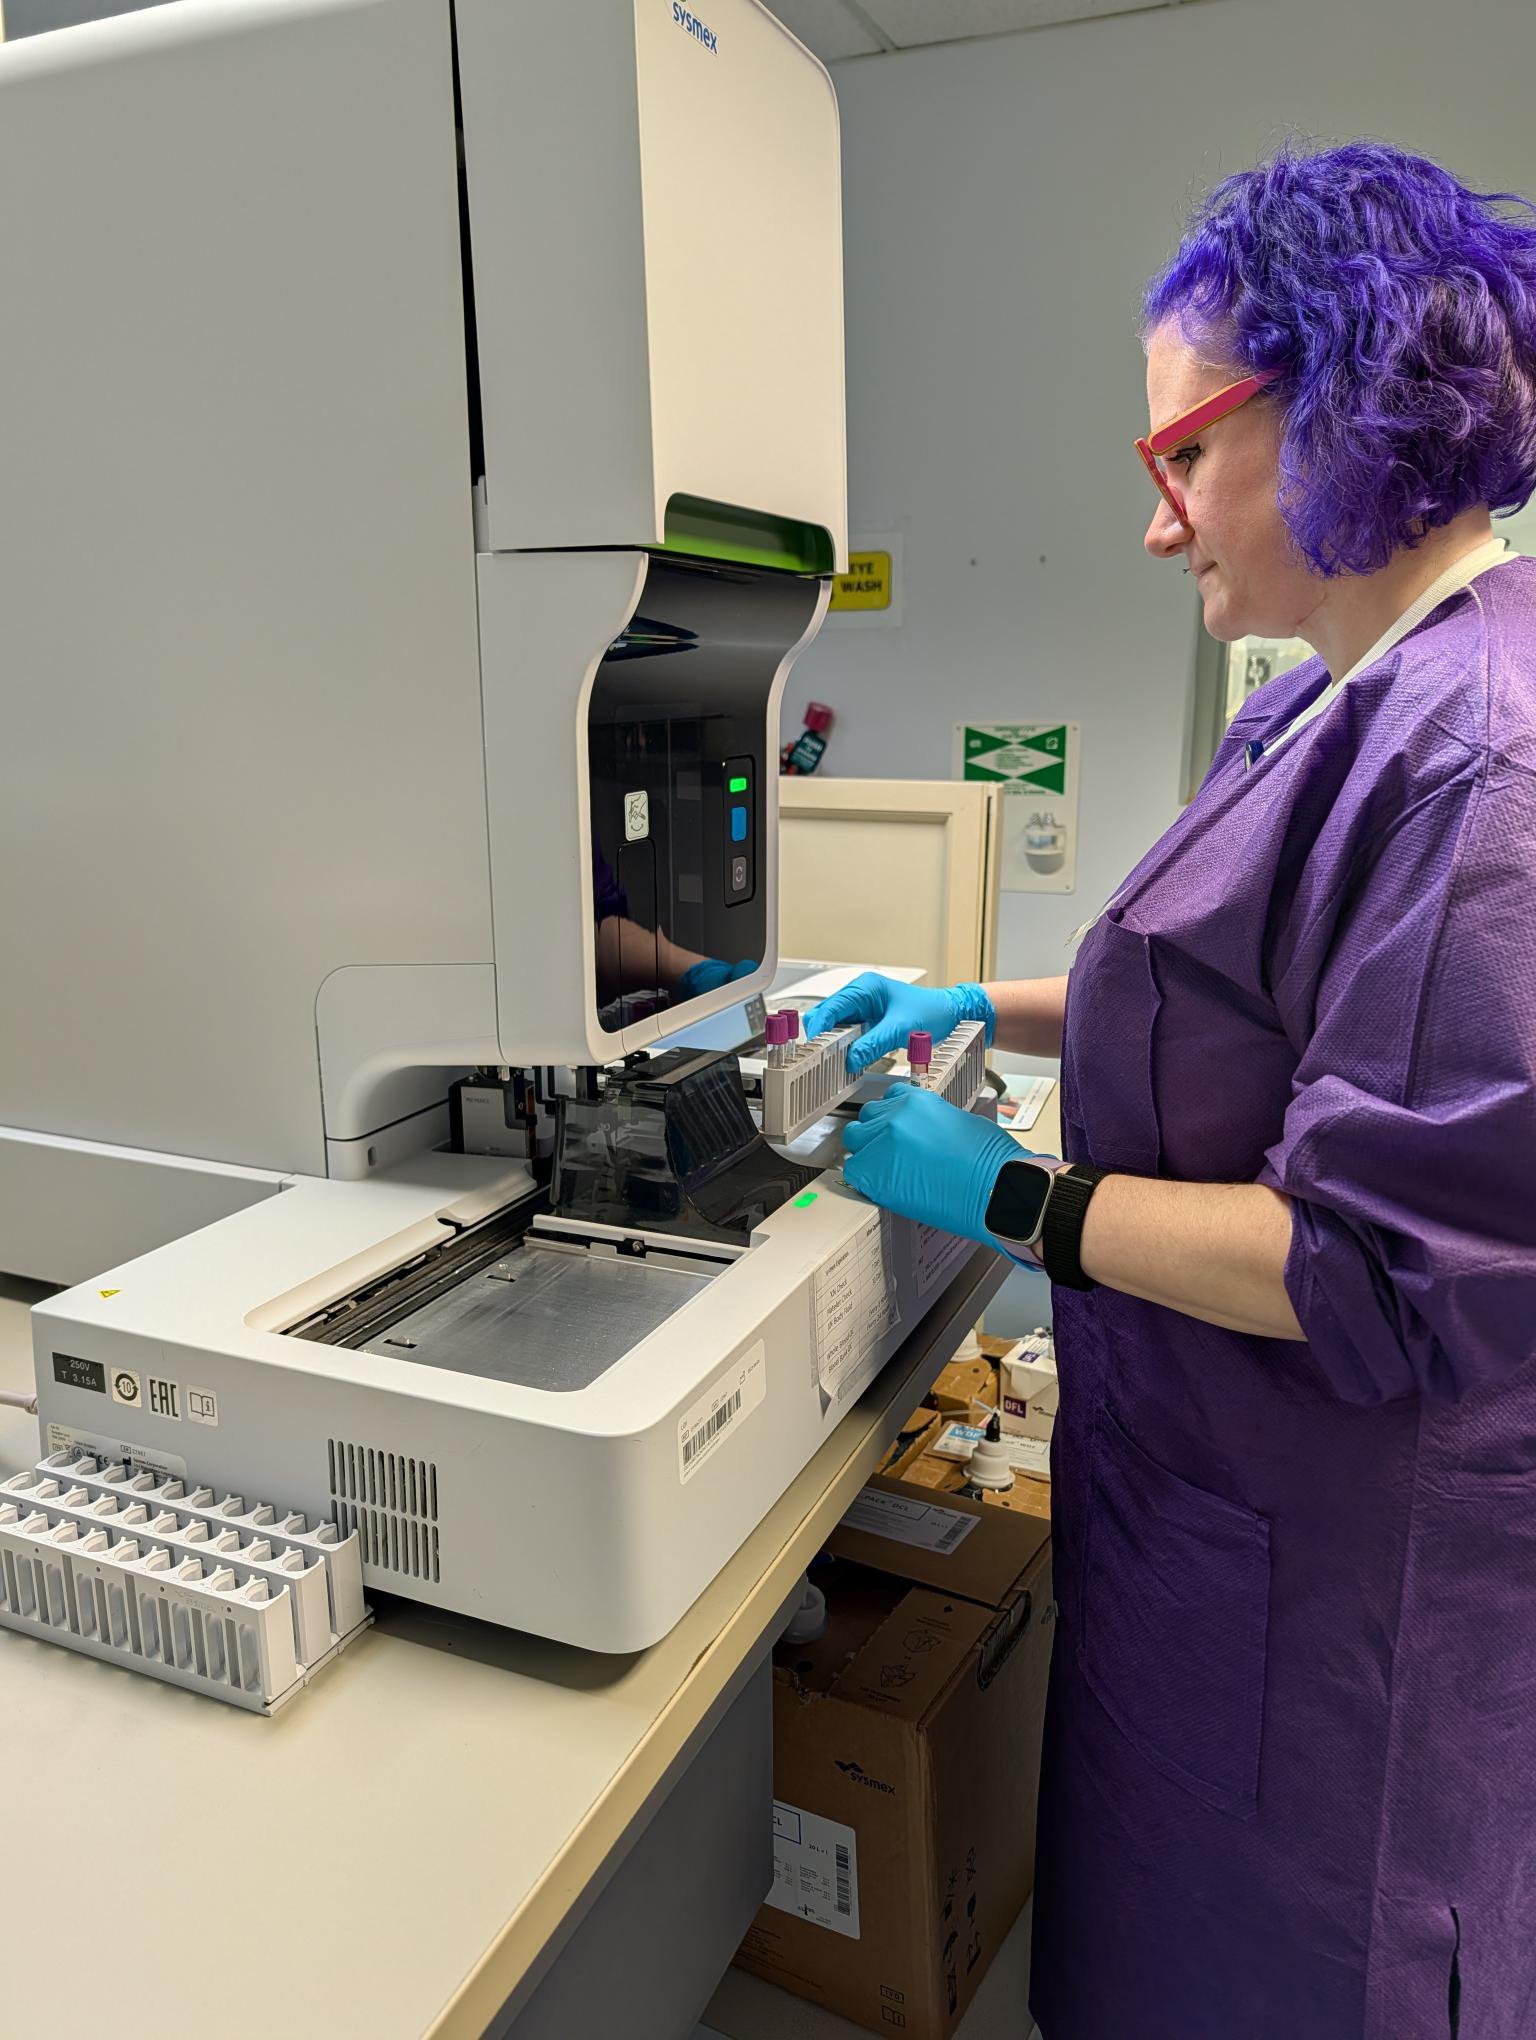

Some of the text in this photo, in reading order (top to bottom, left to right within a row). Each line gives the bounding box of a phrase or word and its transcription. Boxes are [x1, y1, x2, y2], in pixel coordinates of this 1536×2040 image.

[672, 2, 718, 54] sysmex
[849, 562, 875, 575] EYE
[841, 580, 883, 593] WASH
[70, 1359, 90, 1372] 250V
[61, 1370, 97, 1387] T 3.15A
[122, 1381, 132, 1394] 10
[149, 1378, 179, 1418] EAC
[1004, 1400, 1024, 1414] DFL
[850, 1771, 897, 1796] sysmex
